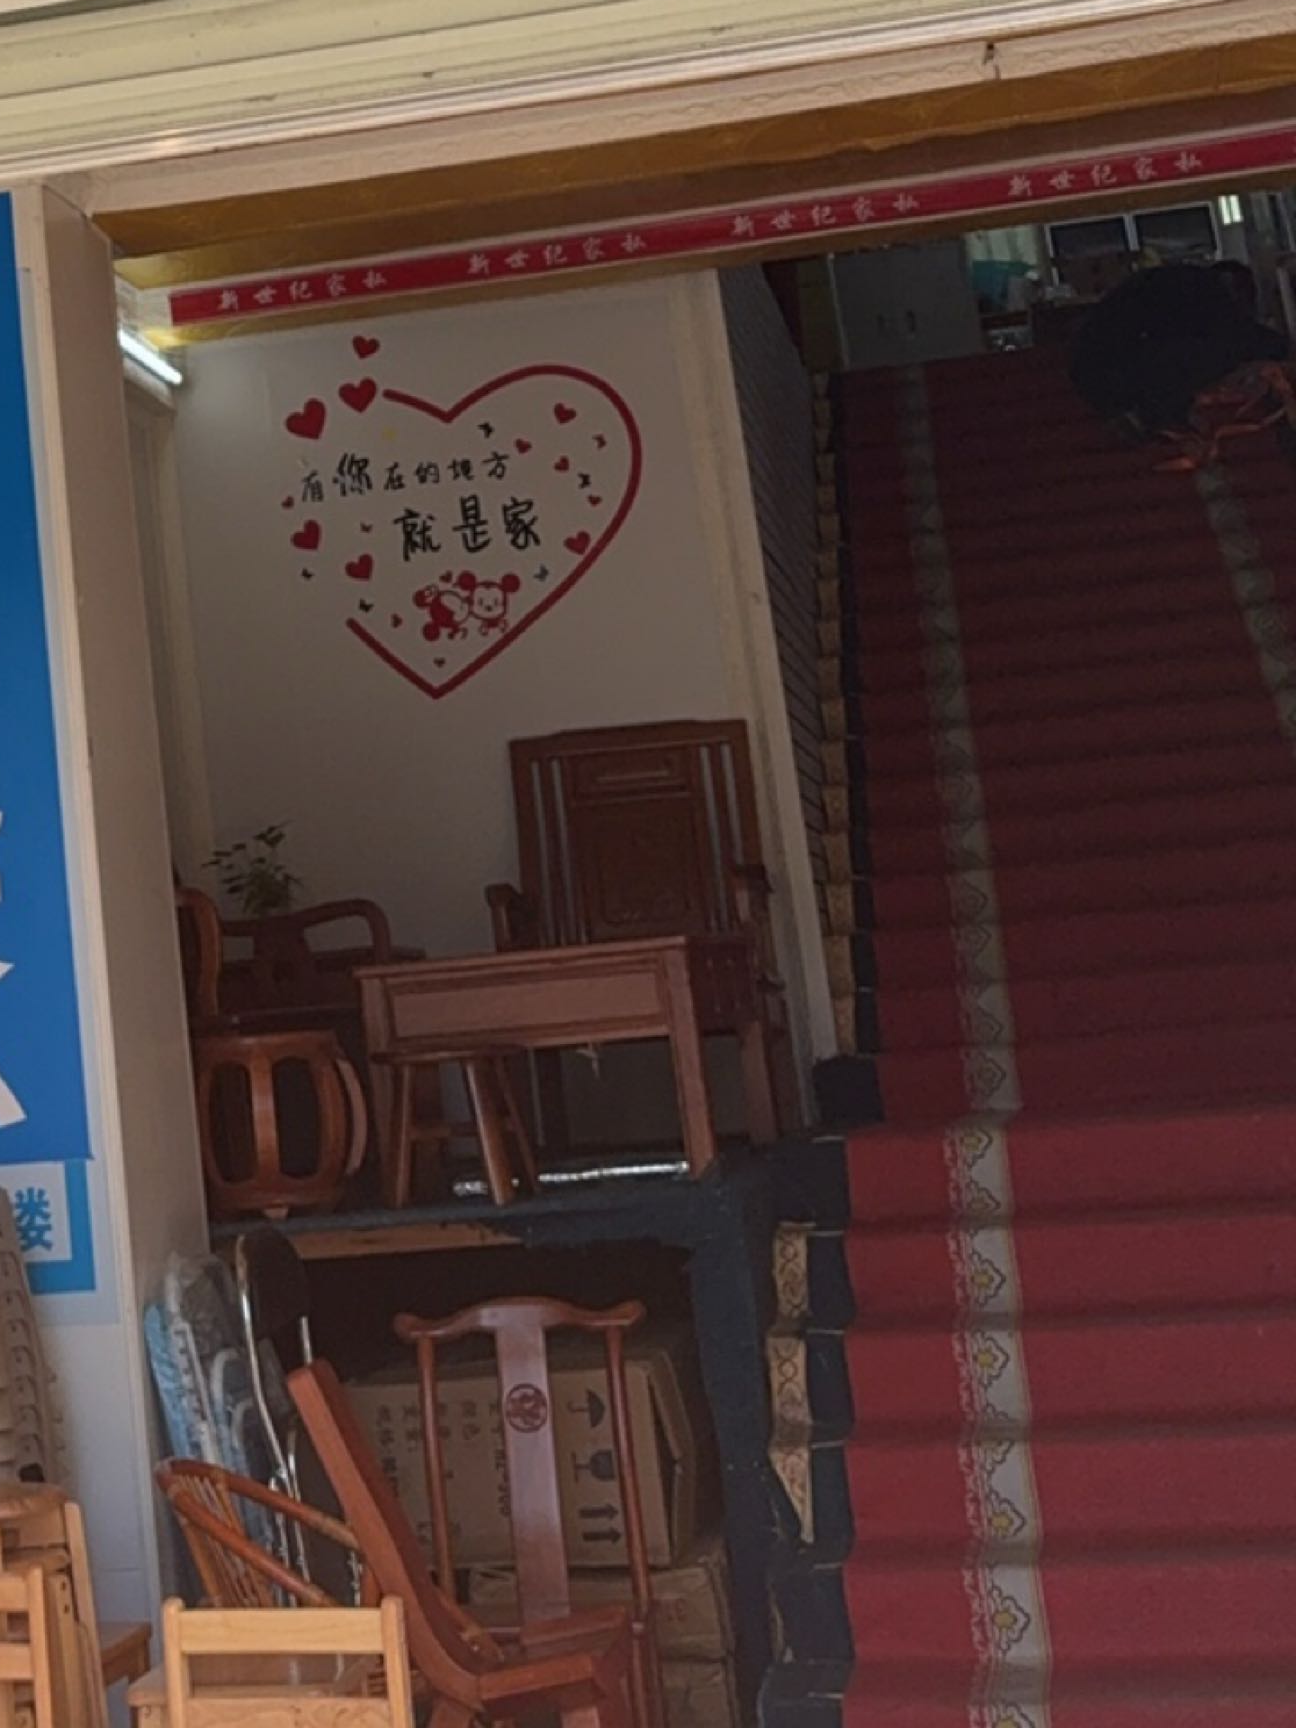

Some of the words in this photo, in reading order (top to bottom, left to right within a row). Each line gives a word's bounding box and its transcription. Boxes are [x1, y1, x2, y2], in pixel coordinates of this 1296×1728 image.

[467, 231, 650, 275] 新世纪家私
[215, 269, 391, 312] 新世纪家私
[300, 452, 512, 503] 有你在的地方
[394, 494, 543, 562] 就是家
